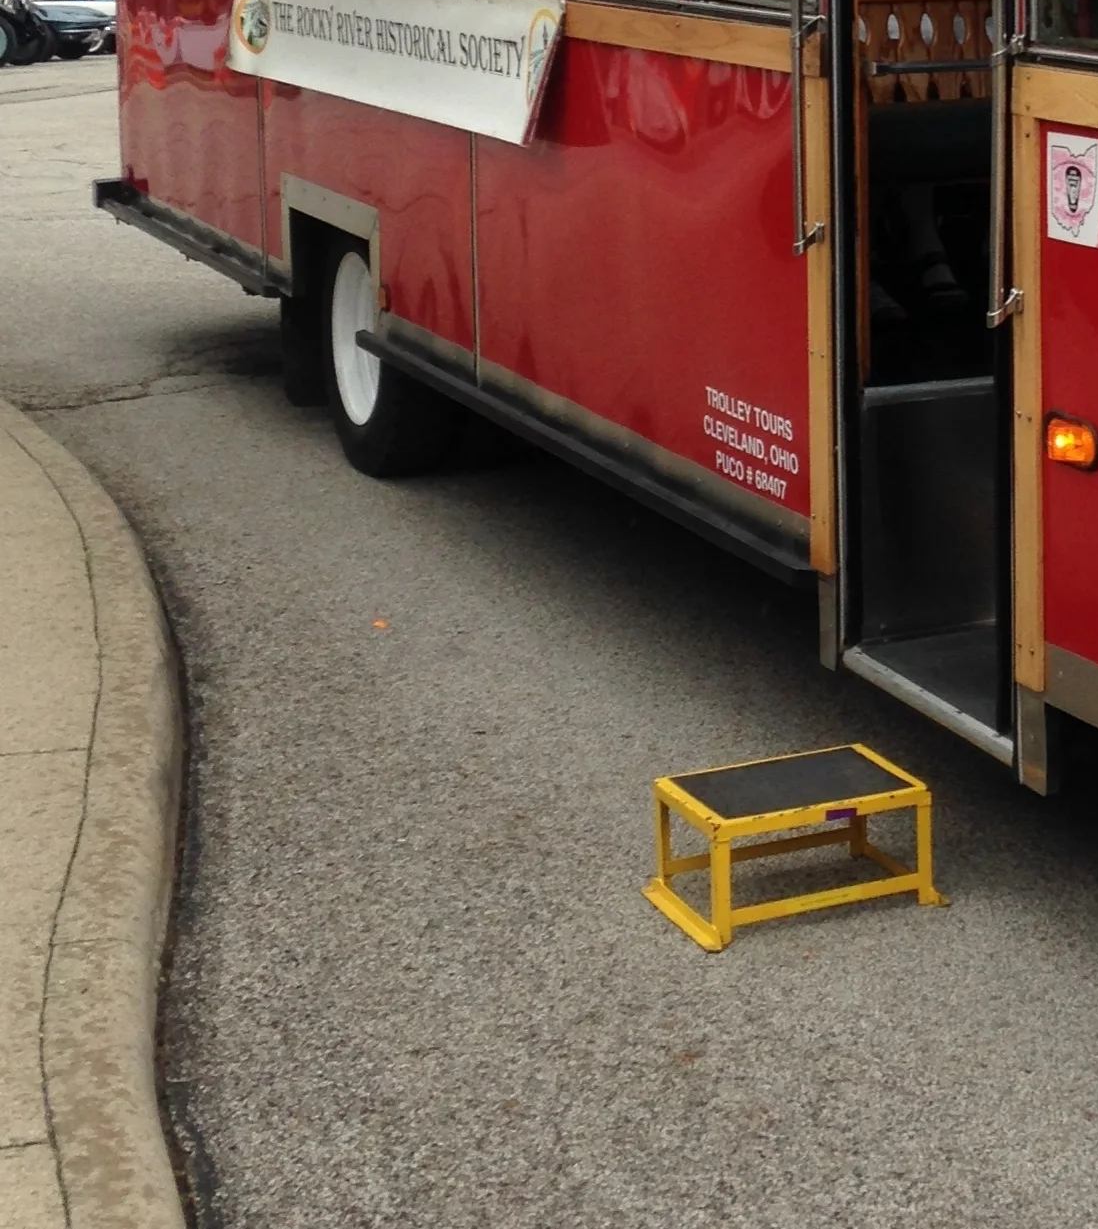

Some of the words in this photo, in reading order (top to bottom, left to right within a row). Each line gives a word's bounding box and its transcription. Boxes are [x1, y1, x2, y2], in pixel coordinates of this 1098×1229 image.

[273, 1, 295, 34] THE
[297, 5, 334, 48] ROCKY
[336, 10, 373, 49] RIVER
[376, 19, 456, 66] HISTORICAL
[459, 32, 526, 79] SOCIETY
[705, 385, 751, 423] TROLLEY
[753, 407, 793, 441] TOURS
[703, 415, 768, 465] CLEVELAND,
[770, 444, 799, 474] OHIO
[716, 450, 744, 481] PUCO
[746, 466, 753, 485] #
[755, 470, 787, 499] 68407
